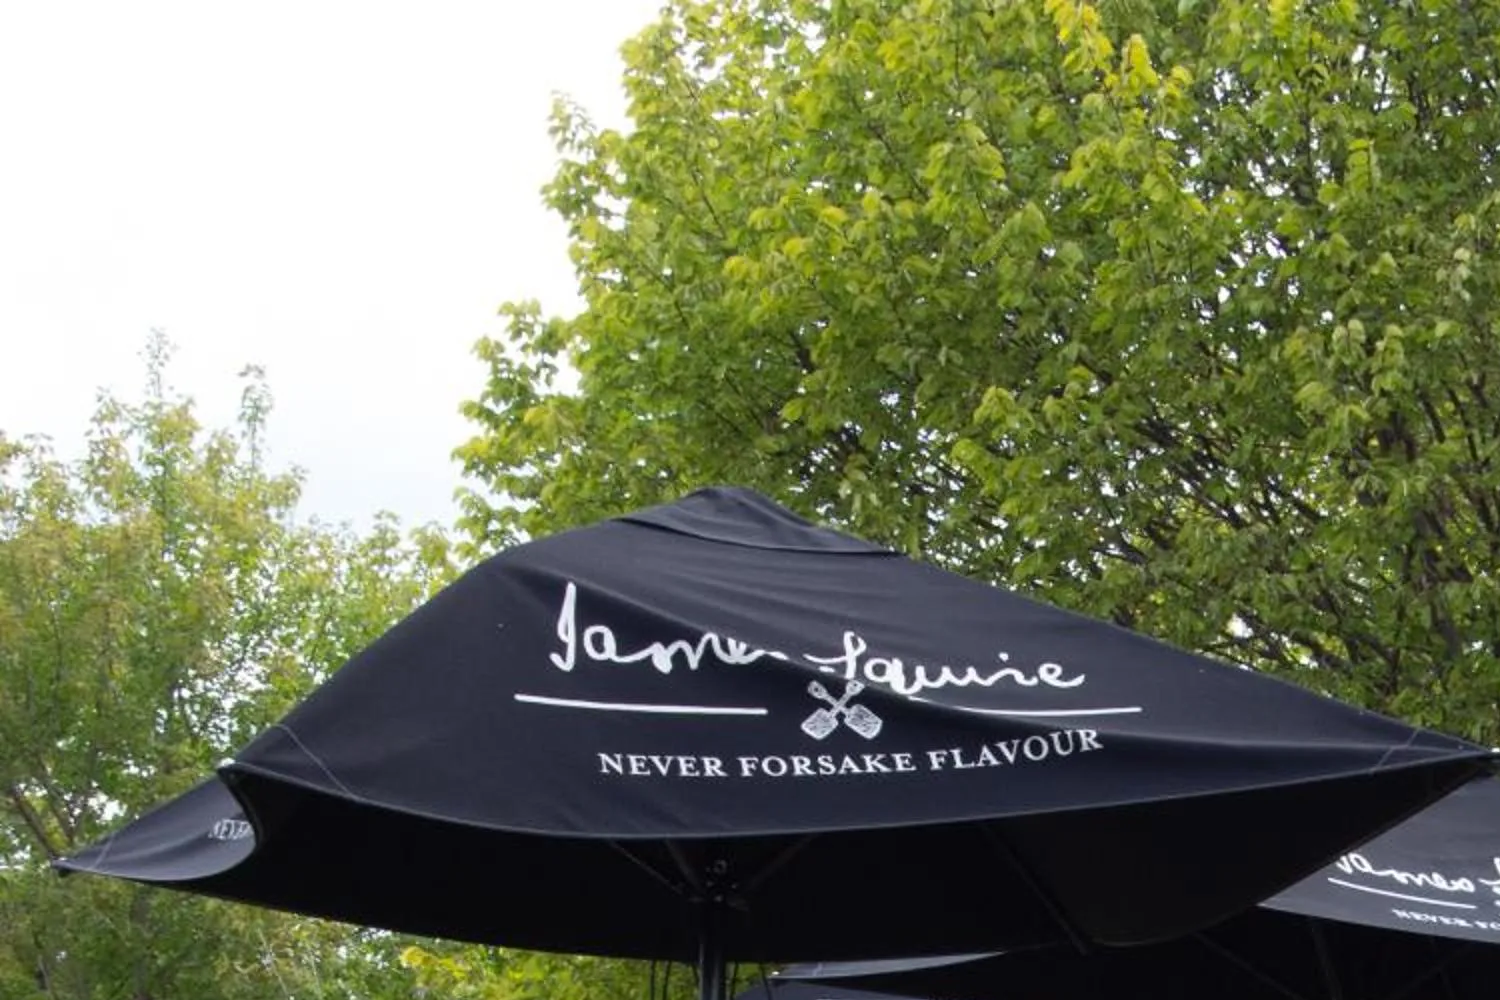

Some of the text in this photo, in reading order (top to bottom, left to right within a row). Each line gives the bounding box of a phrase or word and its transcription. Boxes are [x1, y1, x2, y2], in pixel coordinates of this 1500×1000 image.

[550, 582, 789, 674] Jame
[598, 727, 1104, 779] NEVER FORSAKE FLAVOUR
[1335, 852, 1476, 893] ames
[1392, 908, 1474, 928] NEVER
